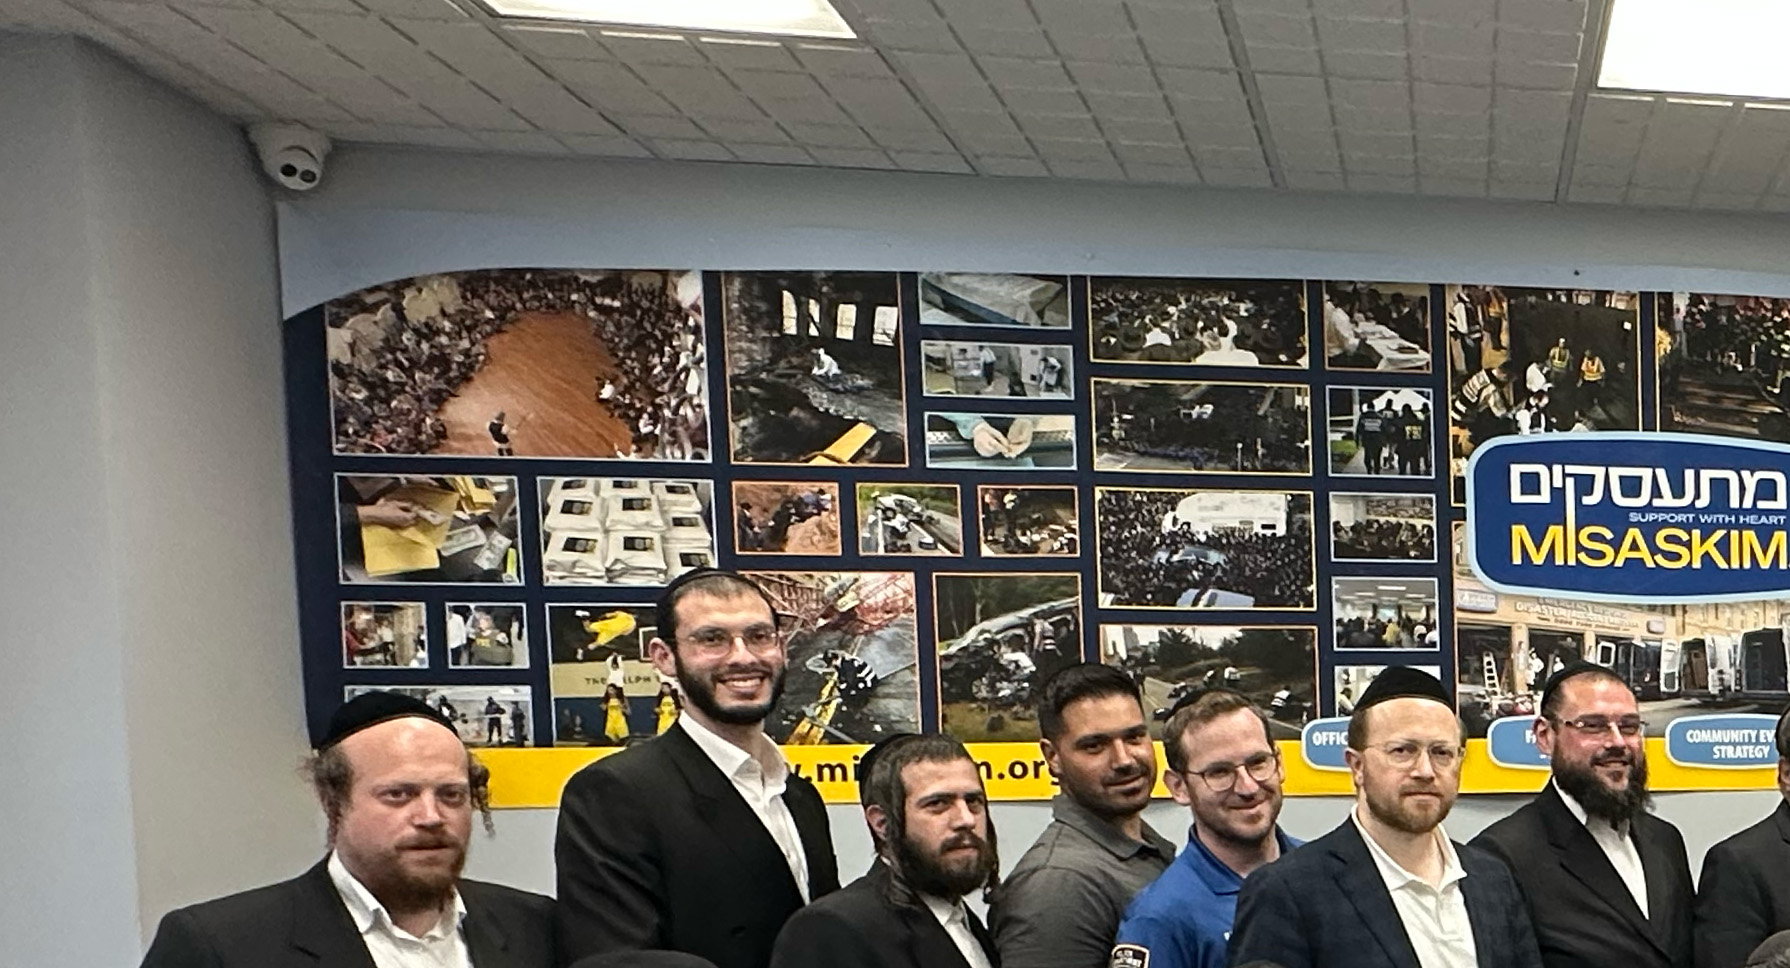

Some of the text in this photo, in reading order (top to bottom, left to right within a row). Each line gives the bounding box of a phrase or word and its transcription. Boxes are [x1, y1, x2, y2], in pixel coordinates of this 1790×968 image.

[1510, 463, 1788, 510] מתעסקים
[1628, 512, 1787, 526] SUPPORT WITH HEART
[1312, 730, 1348, 746] OFFIC
[1686, 729, 1776, 743] COMMUNITY EV
[1712, 745, 1769, 759] STRATEGY
